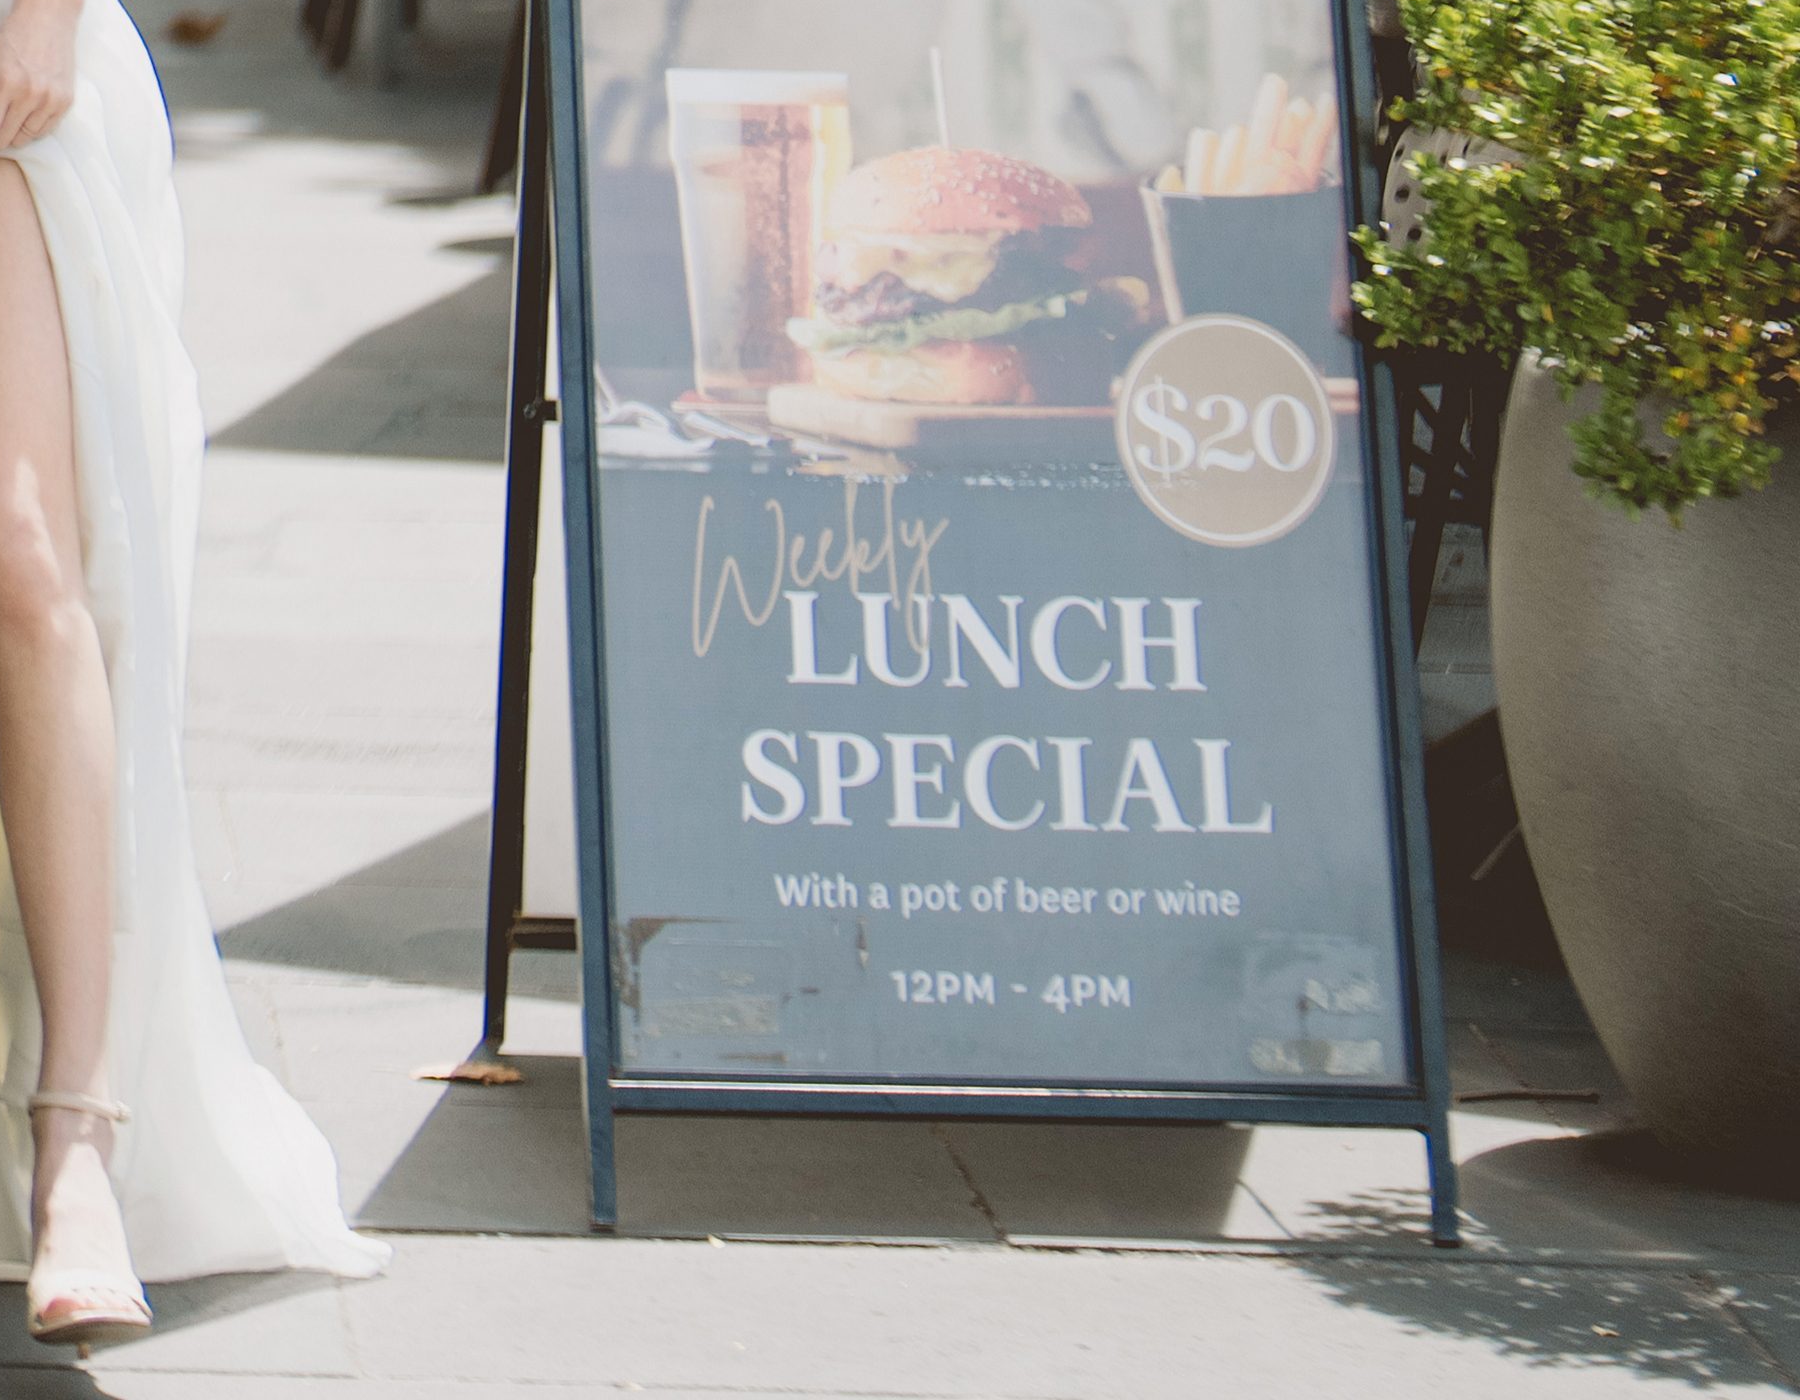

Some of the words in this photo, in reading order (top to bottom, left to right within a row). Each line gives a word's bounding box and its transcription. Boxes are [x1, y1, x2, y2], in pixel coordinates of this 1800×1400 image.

[1132, 376, 1318, 487] $20
[692, 460, 950, 658] Weekly
[782, 589, 1208, 692] LUNCH
[740, 728, 1274, 834] SPECIAL
[772, 872, 860, 909] With
[868, 882, 891, 910] a
[901, 880, 963, 918] pot
[969, 876, 1008, 913] of
[1015, 878, 1098, 914] beer
[1107, 886, 1146, 915] or
[1153, 879, 1242, 916] wine
[889, 970, 997, 1004] 12PM
[1041, 973, 1132, 1012] 4PM
